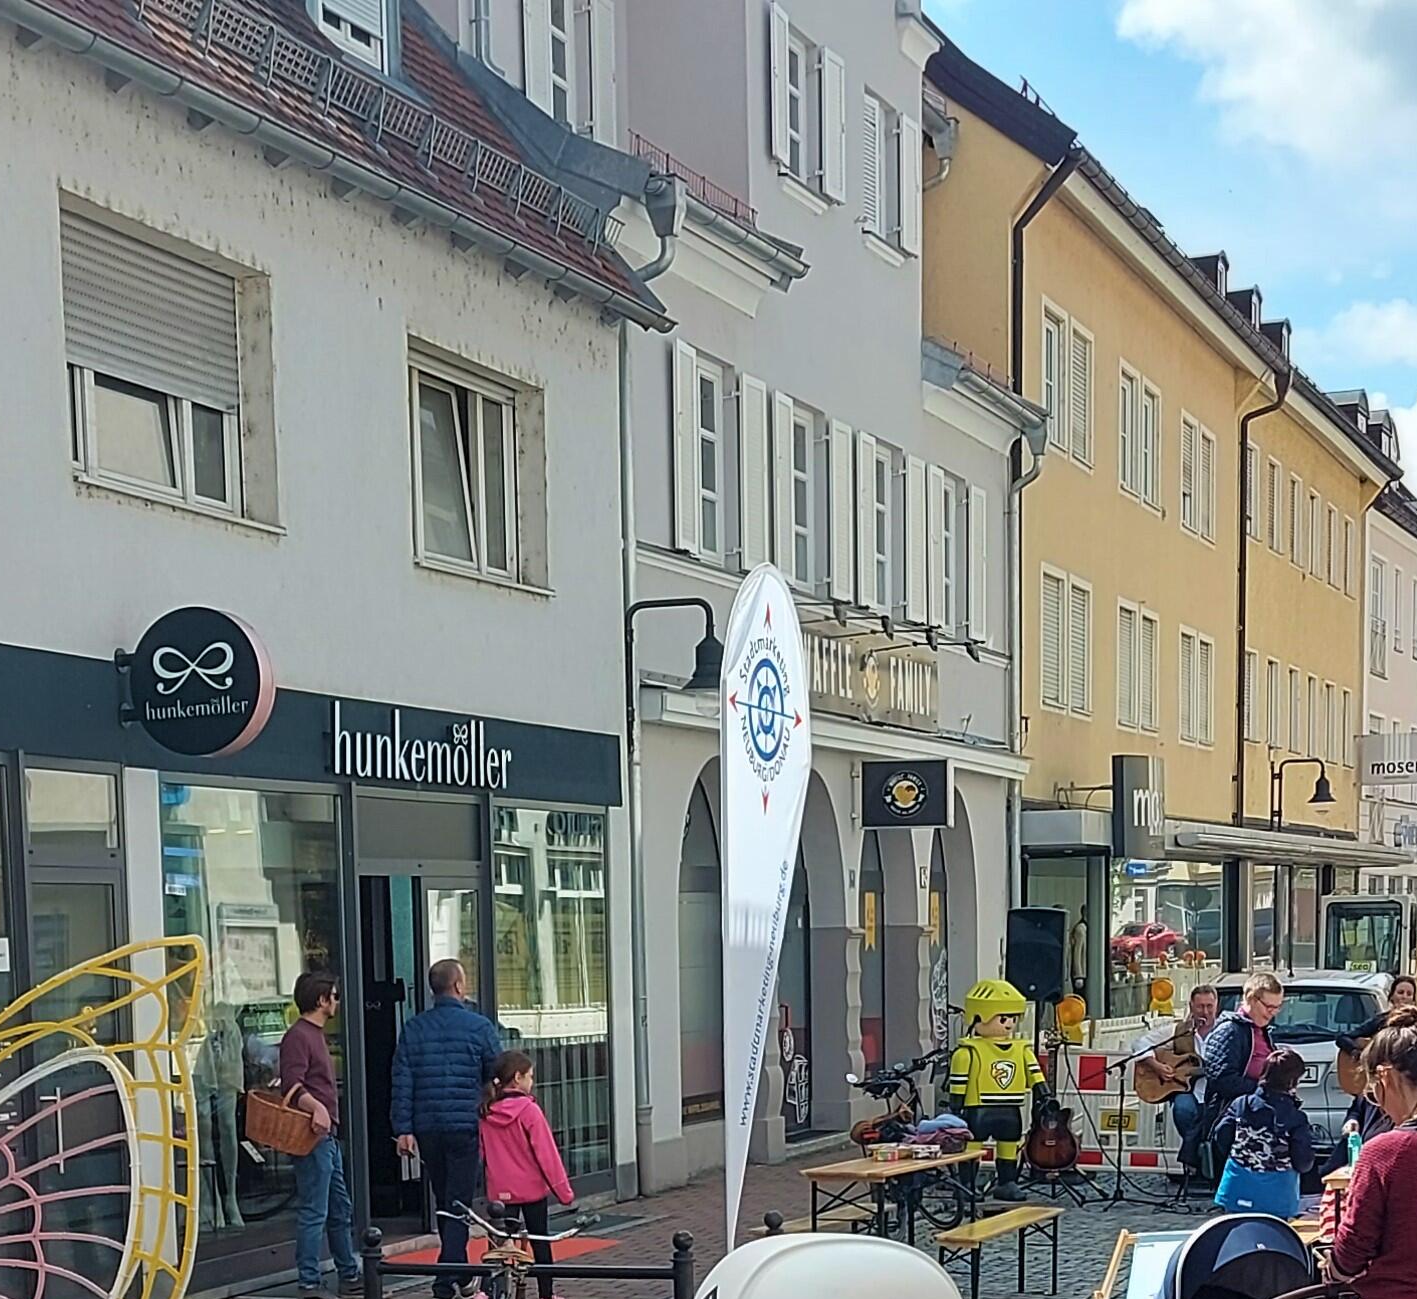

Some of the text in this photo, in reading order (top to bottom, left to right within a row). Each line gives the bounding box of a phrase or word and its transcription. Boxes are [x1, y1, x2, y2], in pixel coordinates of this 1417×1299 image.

[739, 637, 790, 699] Stadtmarketing
[889, 656, 932, 716] FAMILY
[145, 695, 249, 721] hunkemöller
[333, 700, 512, 790] hunkemöller
